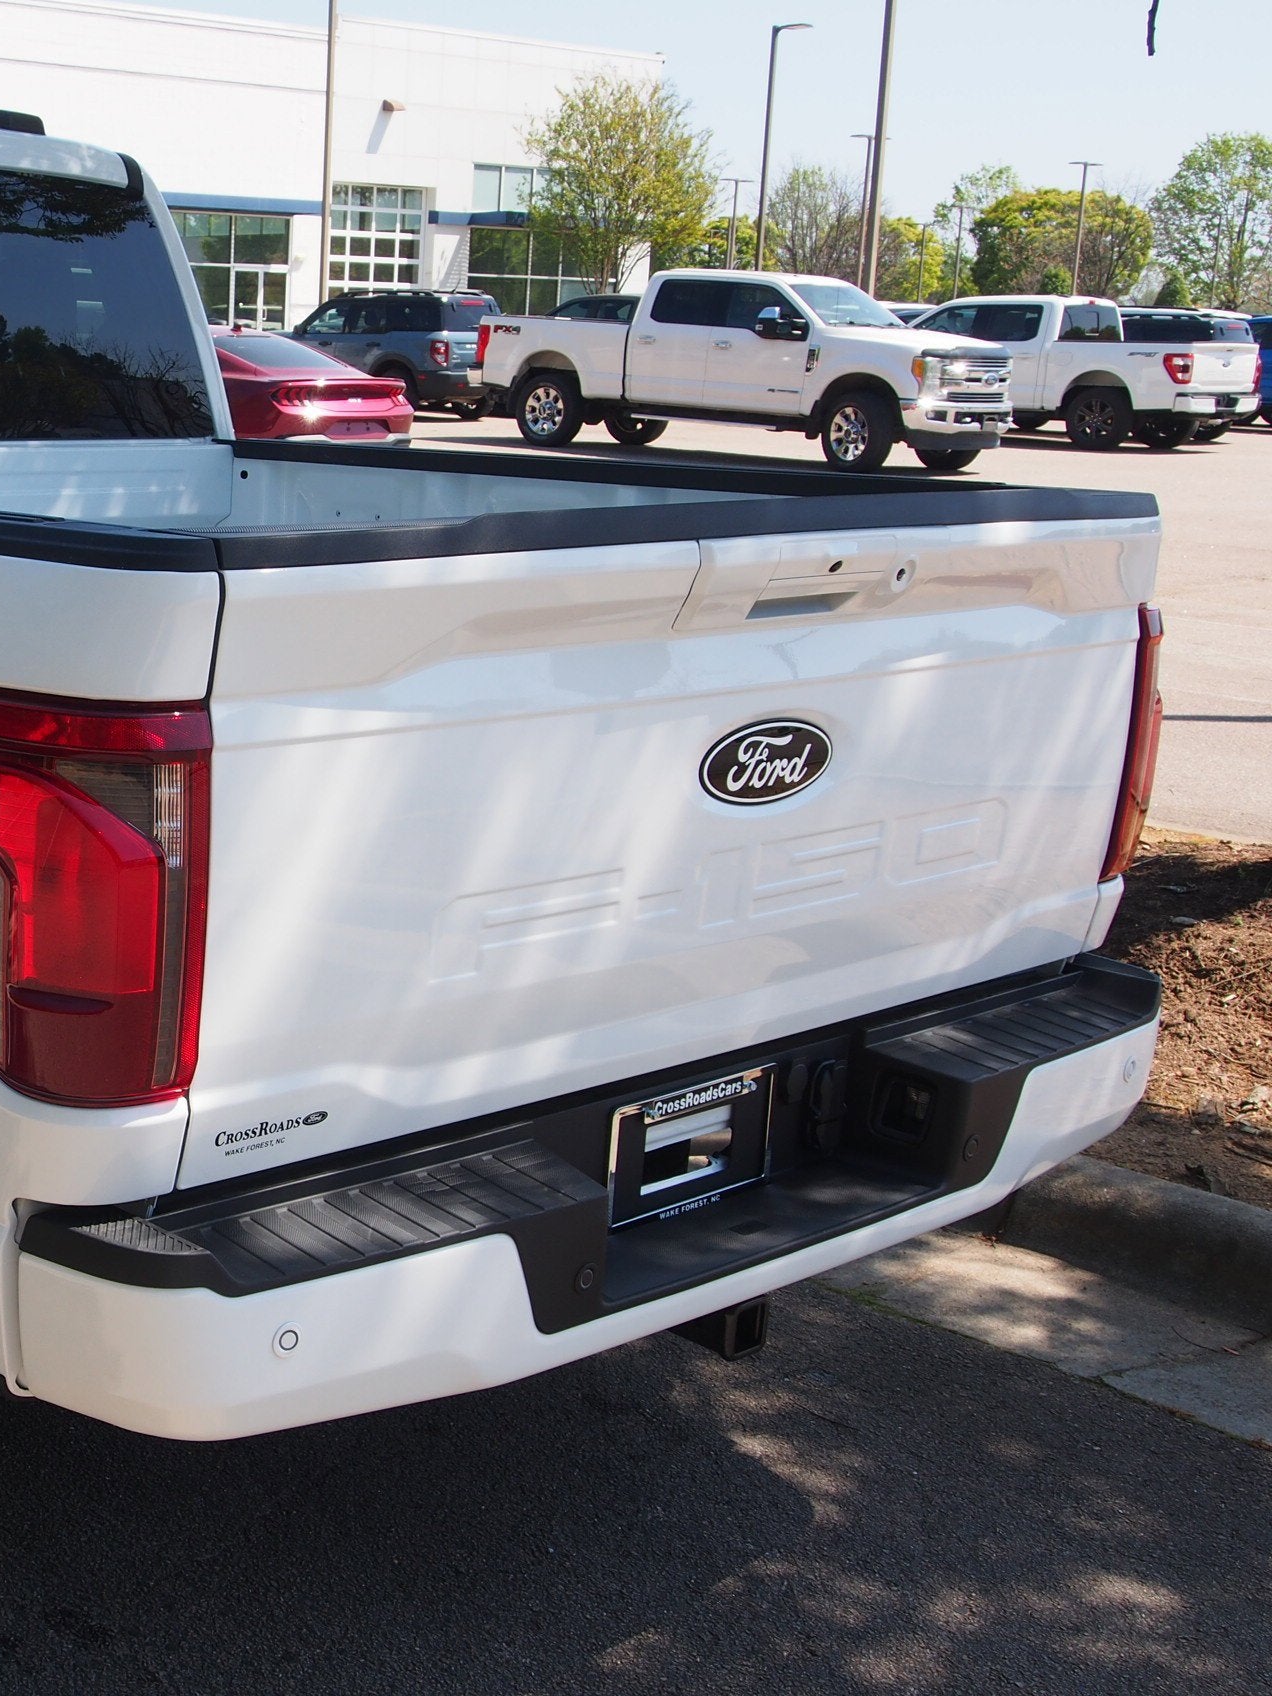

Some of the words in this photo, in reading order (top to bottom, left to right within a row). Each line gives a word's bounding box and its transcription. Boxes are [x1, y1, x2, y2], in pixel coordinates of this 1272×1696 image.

[493, 324, 521, 335] FX4
[726, 733, 812, 792] Ford
[427, 796, 1009, 985] F-150
[653, 1080, 742, 1116] CrossRoadsCars
[224, 1147, 244, 1157] WAKE
[246, 1139, 275, 1152] FOREST,
[659, 1207, 680, 1220] WAKE
[681, 1198, 710, 1213] FOREST,
[711, 1194, 721, 1203] NC
